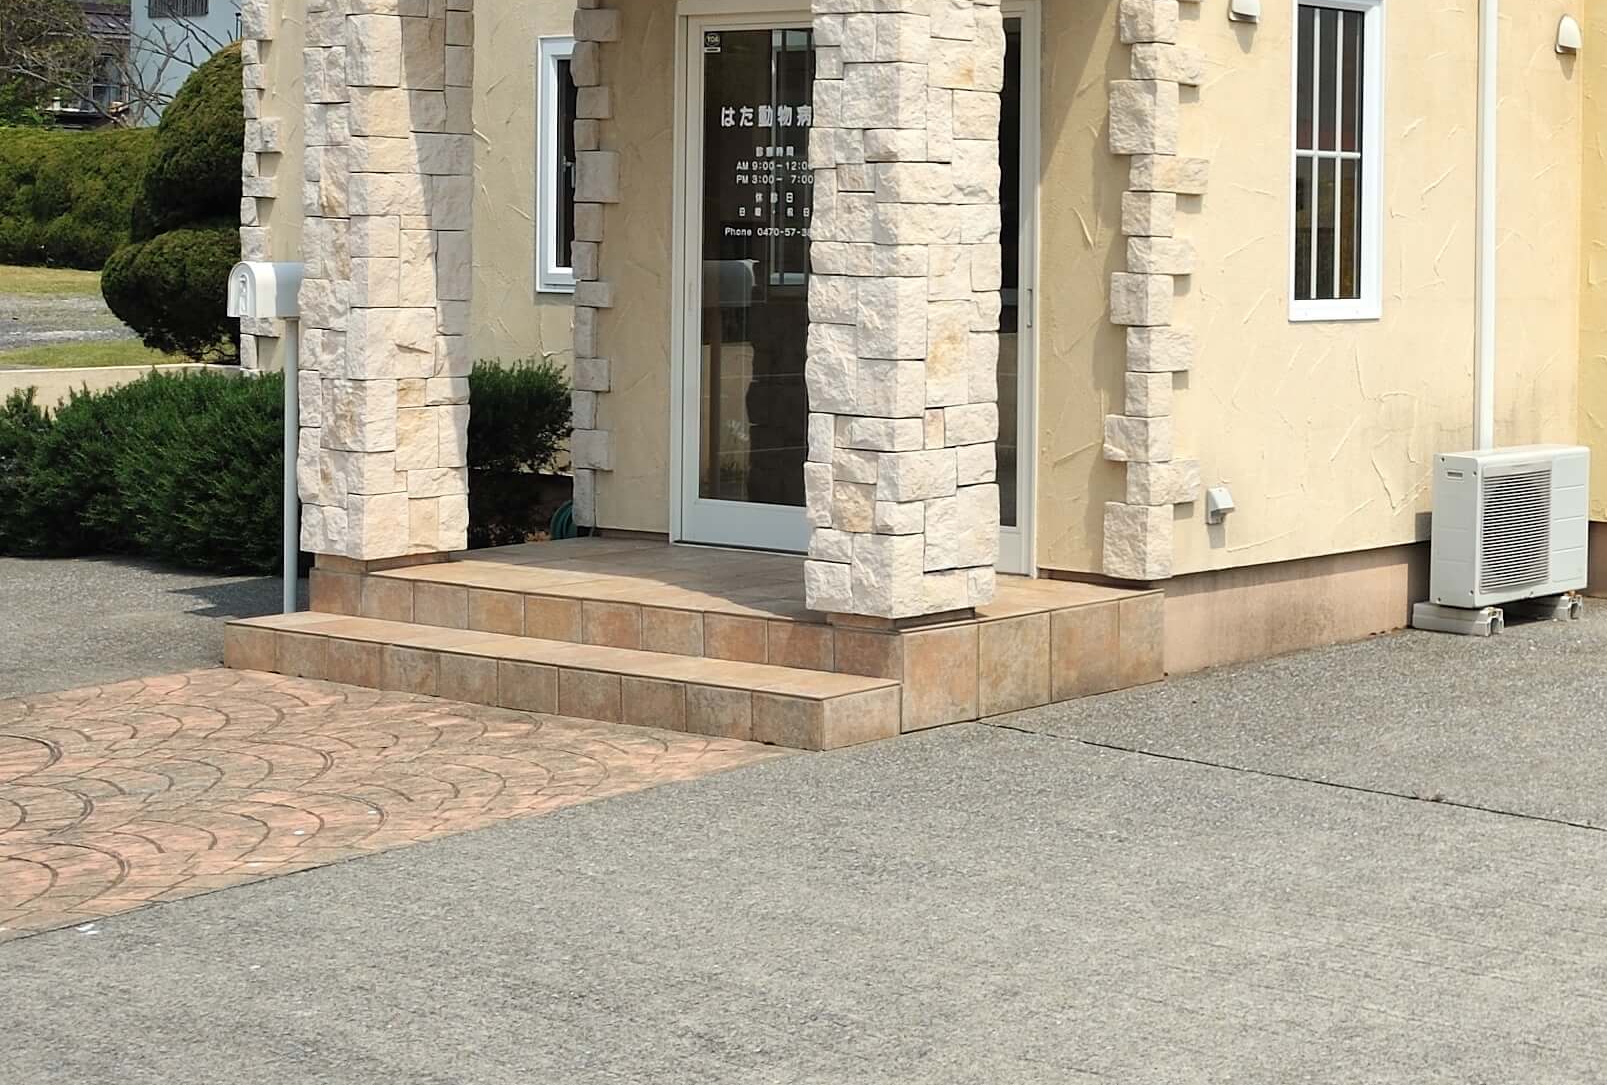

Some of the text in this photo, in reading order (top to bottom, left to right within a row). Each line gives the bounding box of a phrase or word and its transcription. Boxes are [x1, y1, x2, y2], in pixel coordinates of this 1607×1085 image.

[721, 104, 812, 127] はた動物病
[736, 161, 749, 171] AM
[736, 174, 749, 184] PM
[724, 227, 752, 236] Phone
